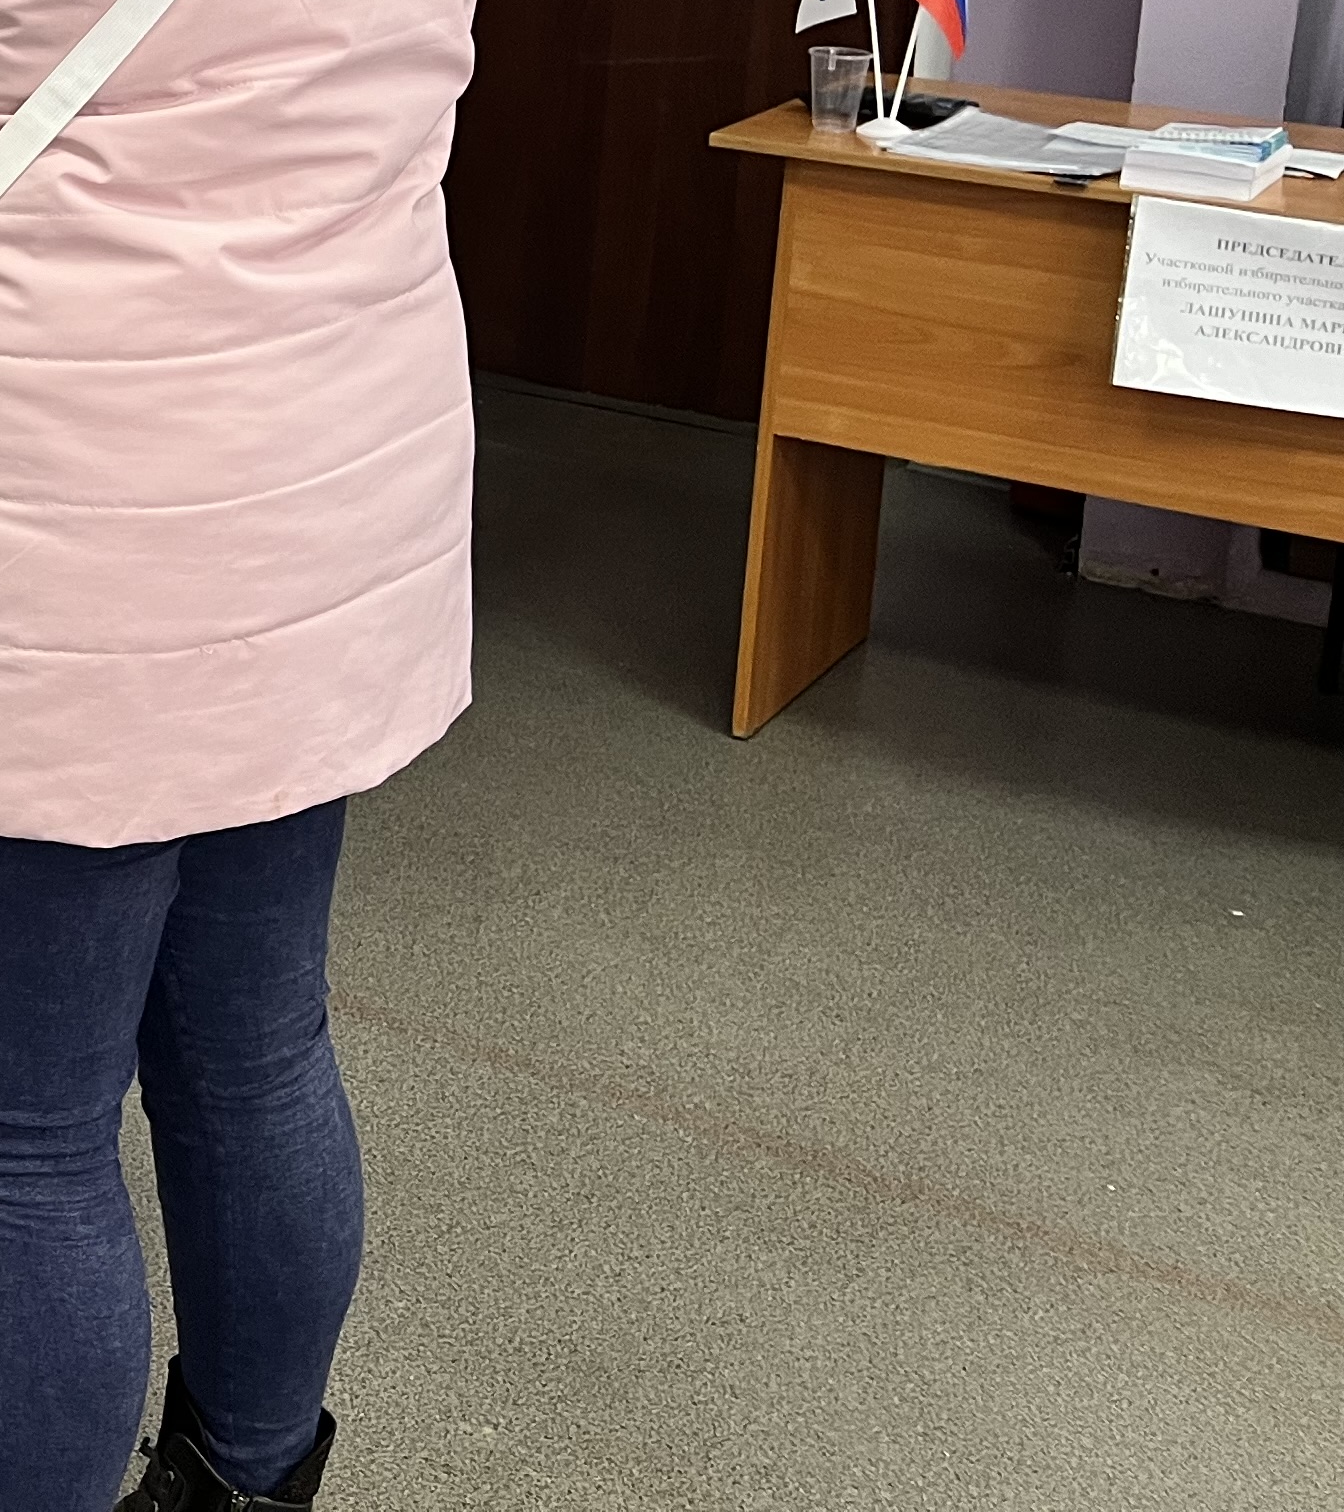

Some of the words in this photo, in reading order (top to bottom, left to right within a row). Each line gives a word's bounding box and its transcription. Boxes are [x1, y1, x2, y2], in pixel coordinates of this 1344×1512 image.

[1145, 251, 1234, 276] Участковой
[1217, 238, 1344, 268] ПРЕДСЕДАТЕ
[1162, 277, 1283, 303] избирательного
[1180, 301, 1294, 329] ЛАШУНИНА
